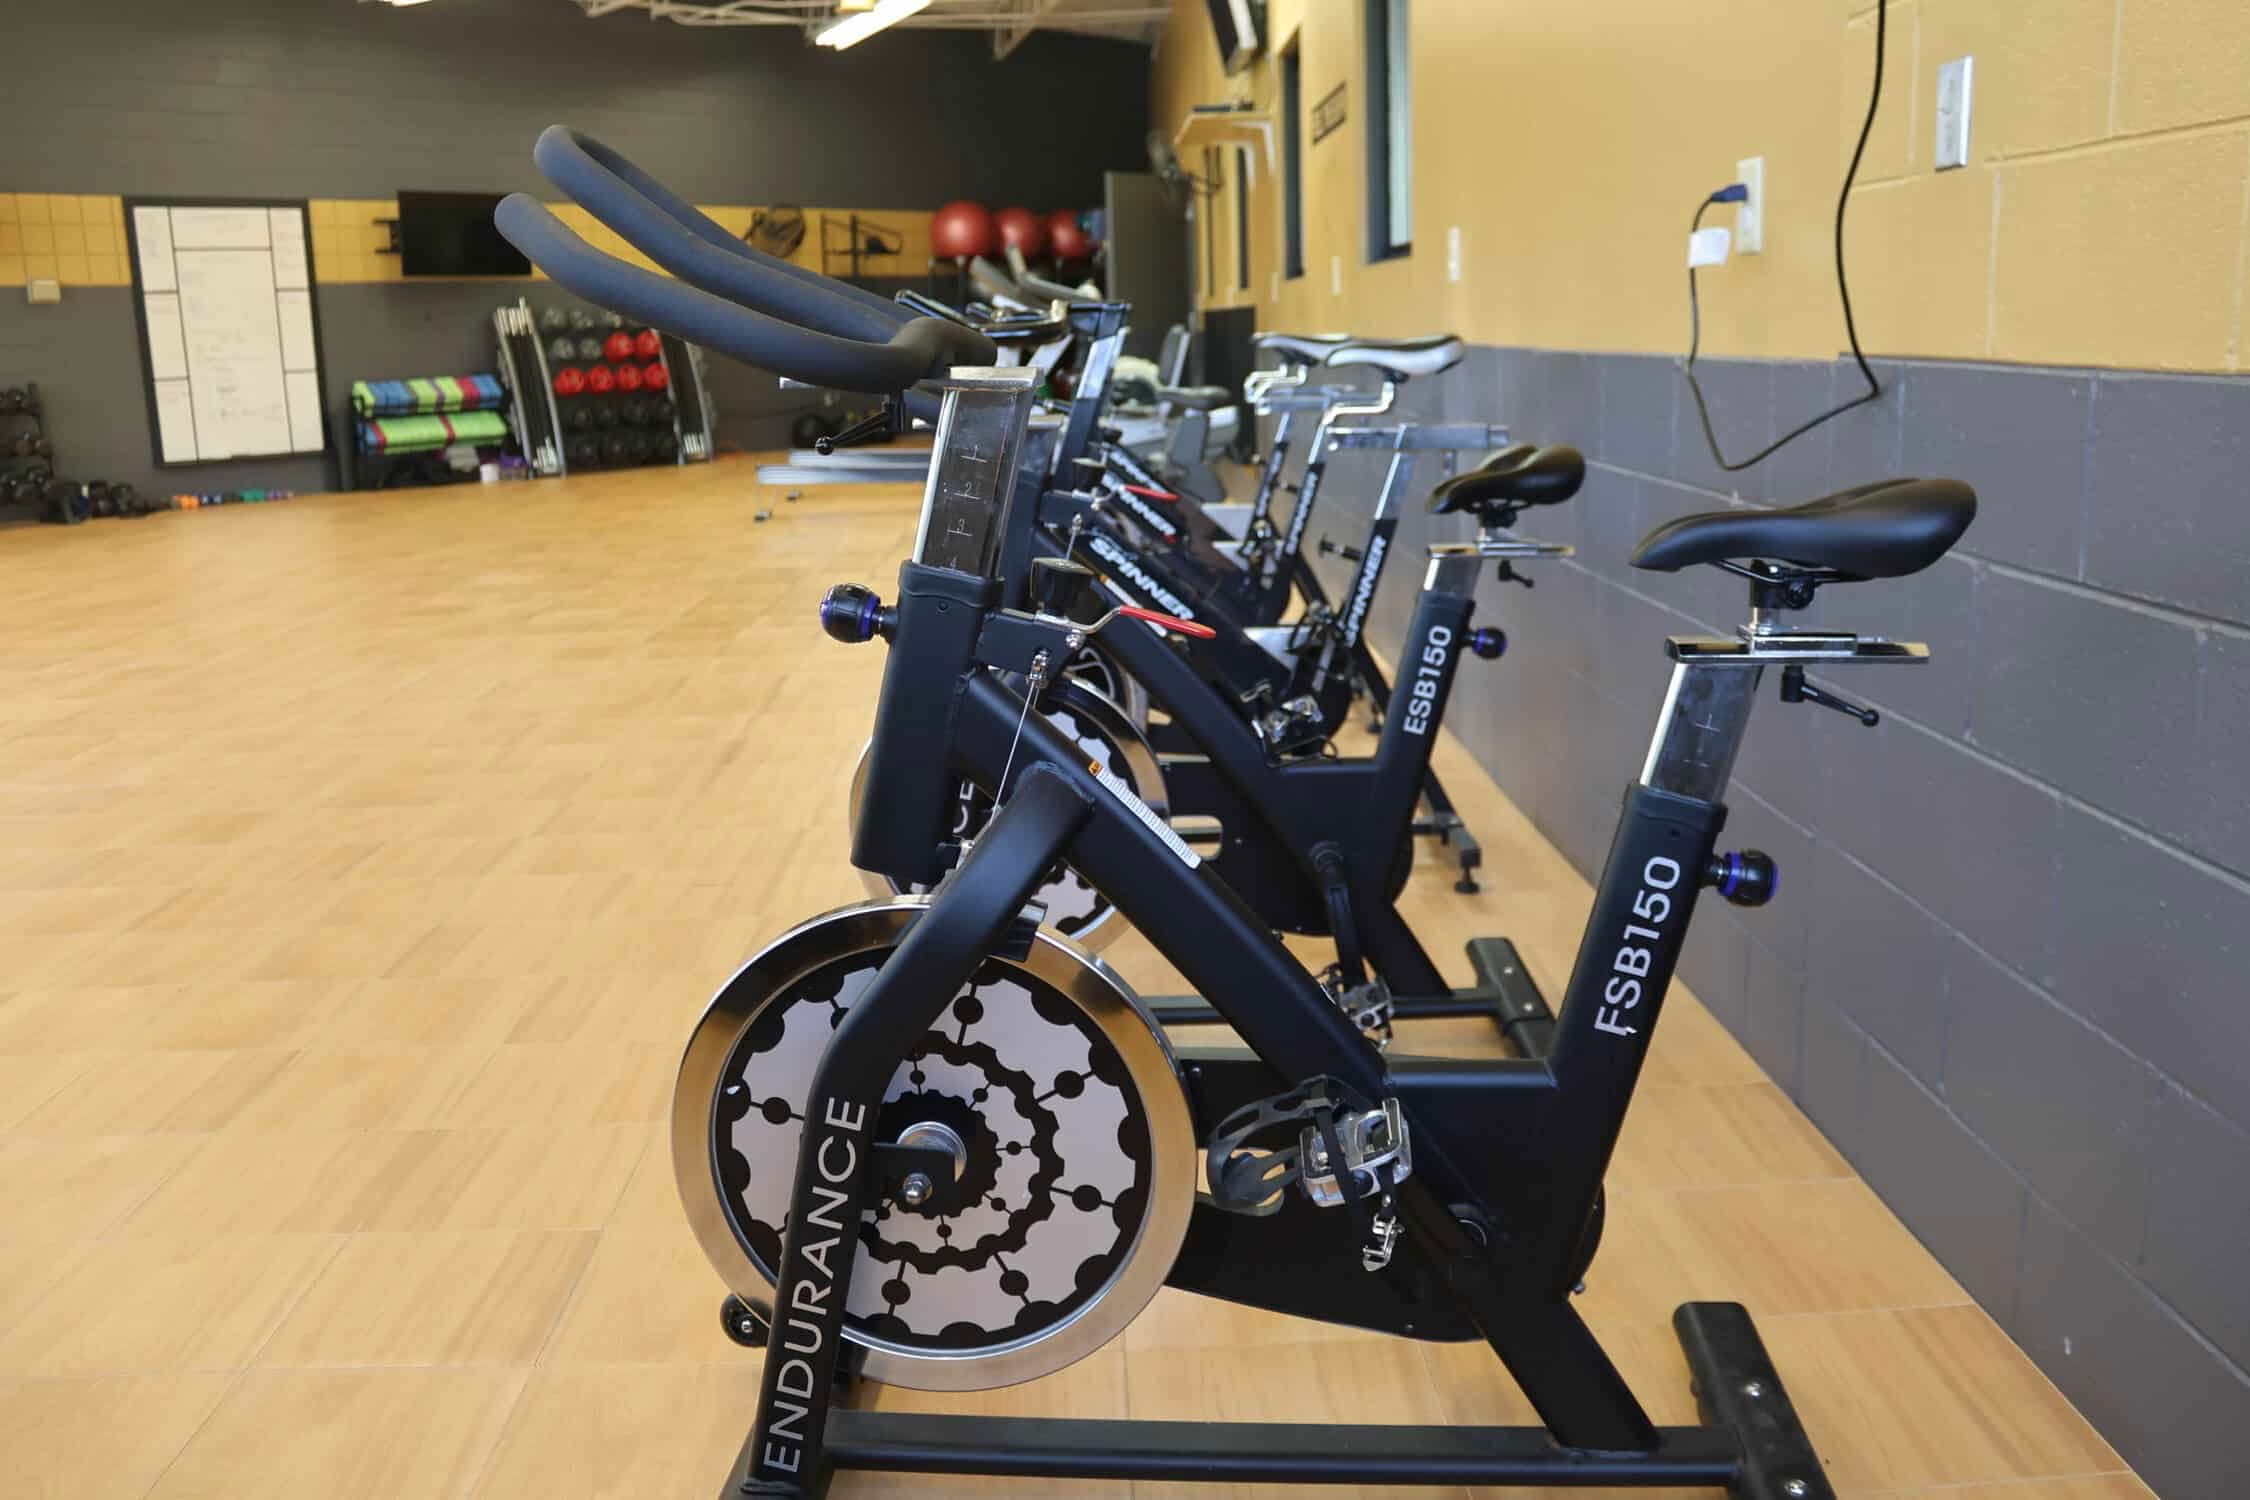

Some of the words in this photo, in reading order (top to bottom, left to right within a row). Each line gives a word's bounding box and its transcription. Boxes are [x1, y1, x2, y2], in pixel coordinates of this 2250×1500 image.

[1089, 536, 1195, 621] SPINNER
[1346, 535, 1388, 649] SPINNER
[1403, 625, 1452, 735] ESB150
[763, 1097, 867, 1473] ENDURANCE
